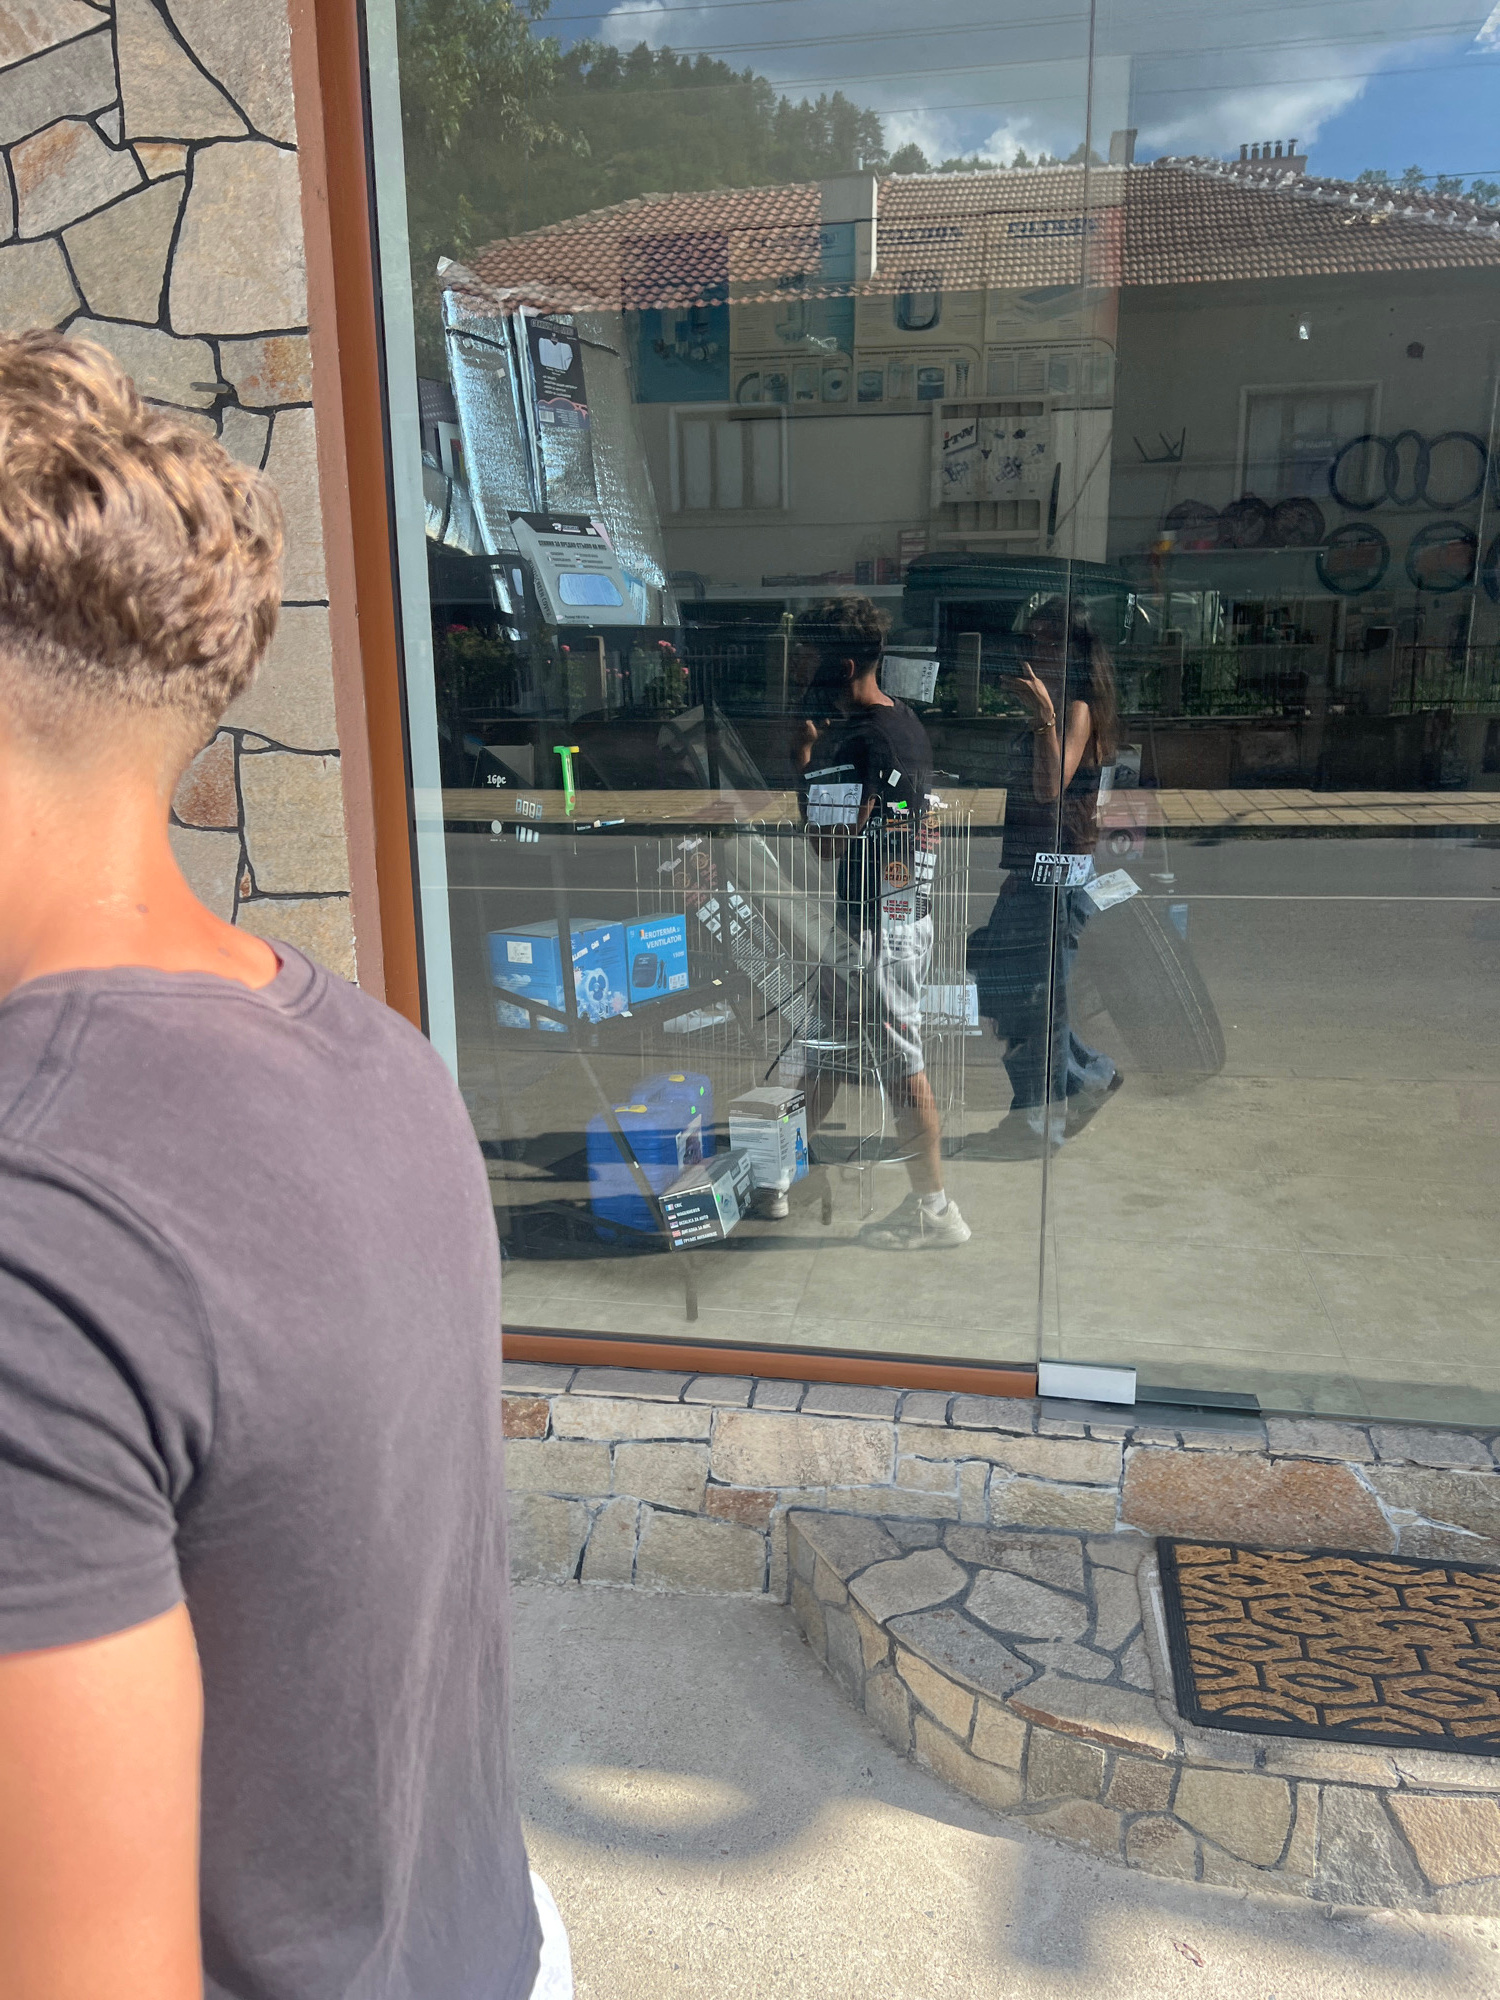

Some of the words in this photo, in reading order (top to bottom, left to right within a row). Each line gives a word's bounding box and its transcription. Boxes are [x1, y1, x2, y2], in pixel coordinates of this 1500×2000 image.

[487, 775, 506, 787] 16pc
[1038, 854, 1070, 863] ONYX
[641, 926, 677, 941] AEROTERMA
[646, 935, 682, 949] VENTILATOR
